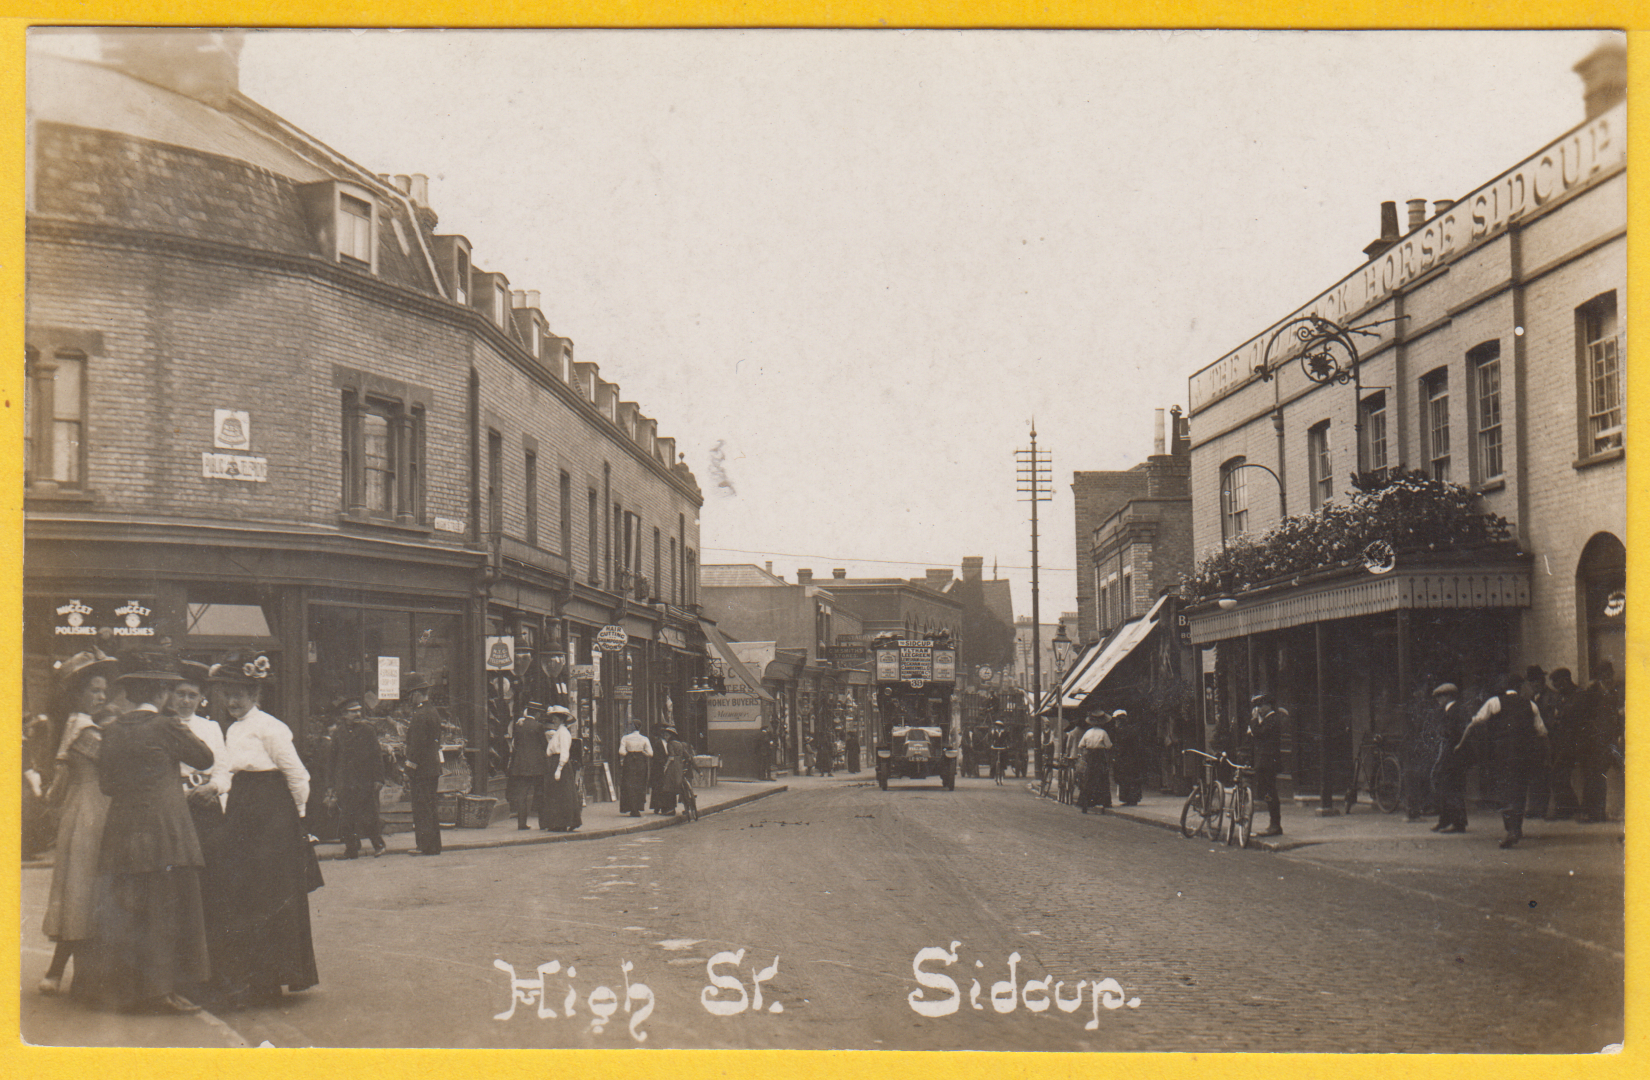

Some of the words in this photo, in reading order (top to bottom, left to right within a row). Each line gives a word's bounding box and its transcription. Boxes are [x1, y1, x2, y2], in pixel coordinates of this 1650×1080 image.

[1208, 353, 1241, 399] THE
[1363, 214, 1457, 309] HORSE
[1469, 119, 1611, 243] SIDCUP
[56, 604, 93, 615] NUGGET
[114, 605, 151, 616] NUGGET
[55, 626, 97, 636] POLISHES
[113, 627, 155, 637] POLISHES
[600, 631, 626, 640] CUTTING
